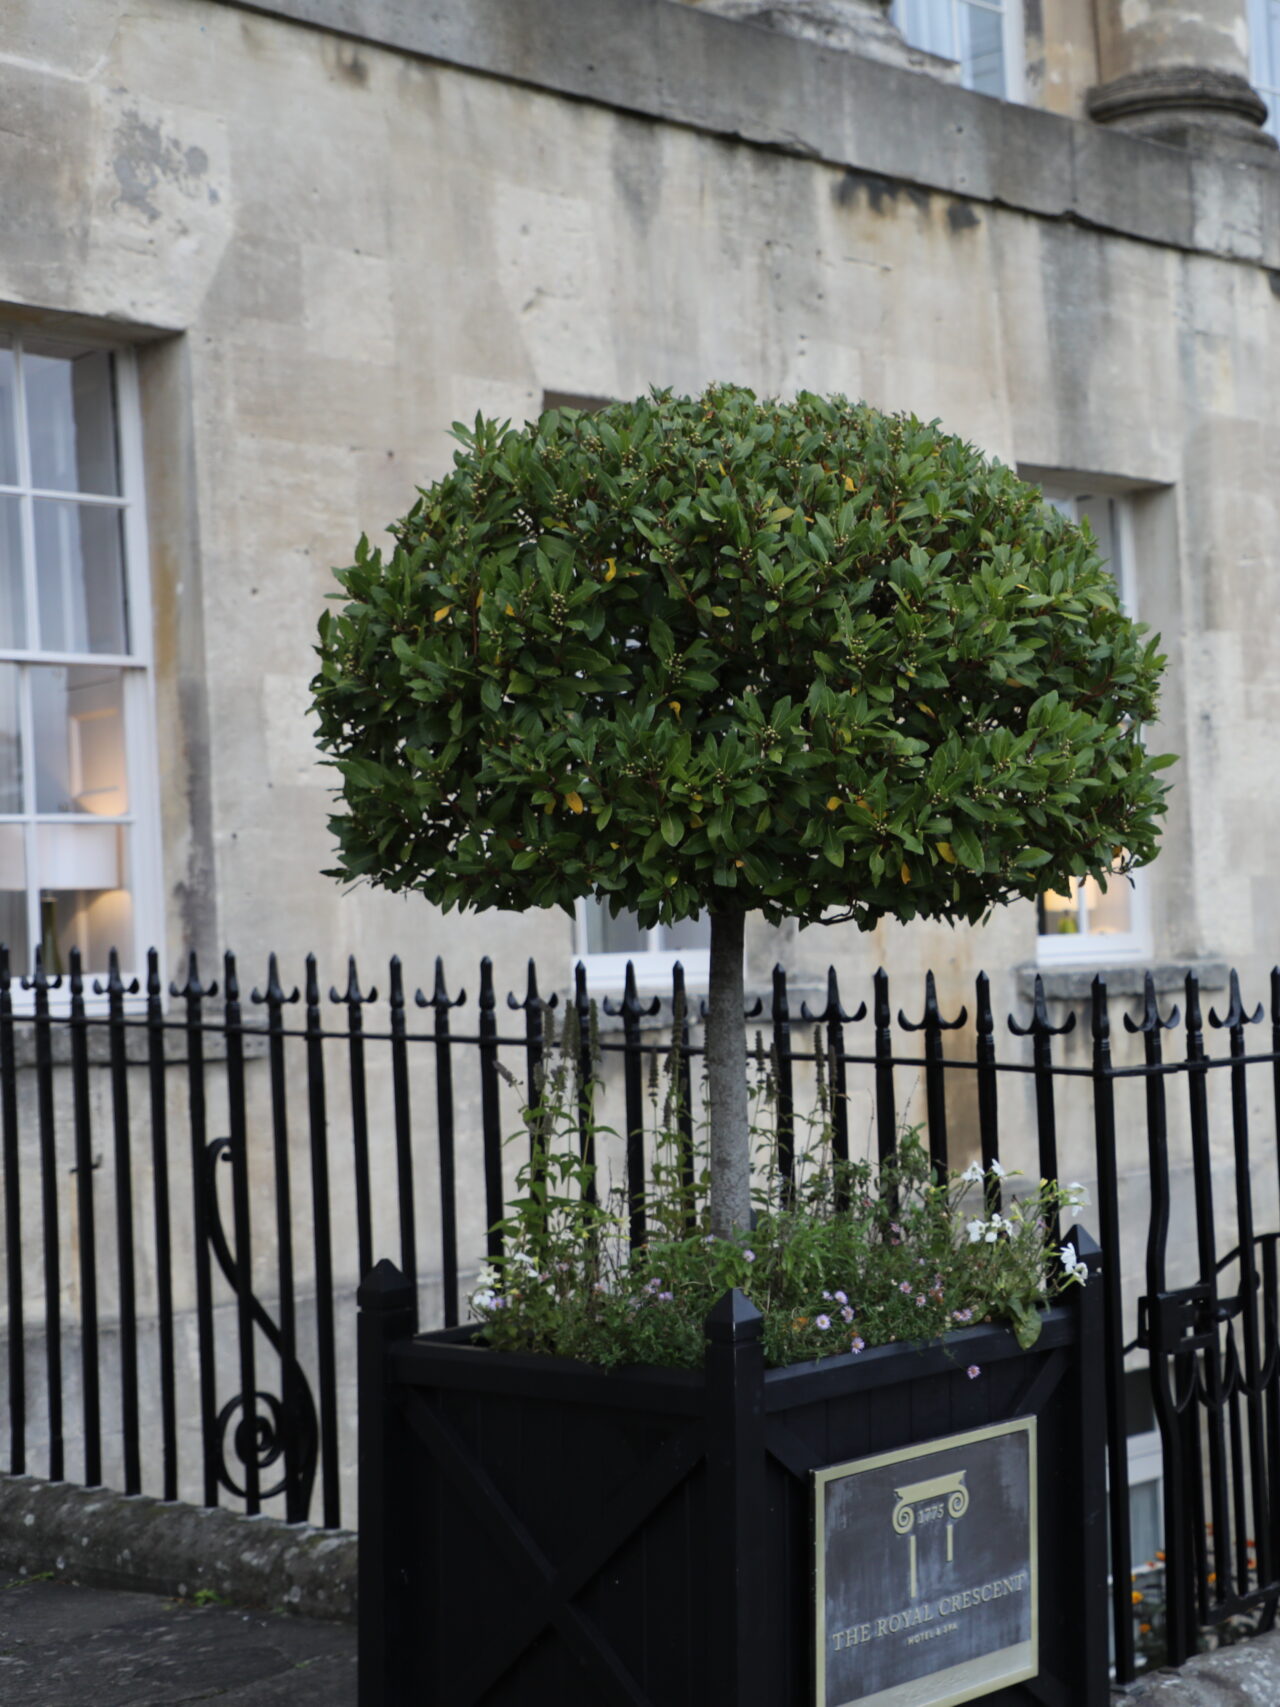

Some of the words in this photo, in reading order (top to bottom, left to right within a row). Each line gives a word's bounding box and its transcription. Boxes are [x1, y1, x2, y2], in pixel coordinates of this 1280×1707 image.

[917, 1503, 944, 1523] 1775
[832, 1623, 873, 1651] THE
[876, 1604, 934, 1638] ROYAL
[938, 1574, 1026, 1617] CRESCENT
[907, 1630, 934, 1645] HOTEL
